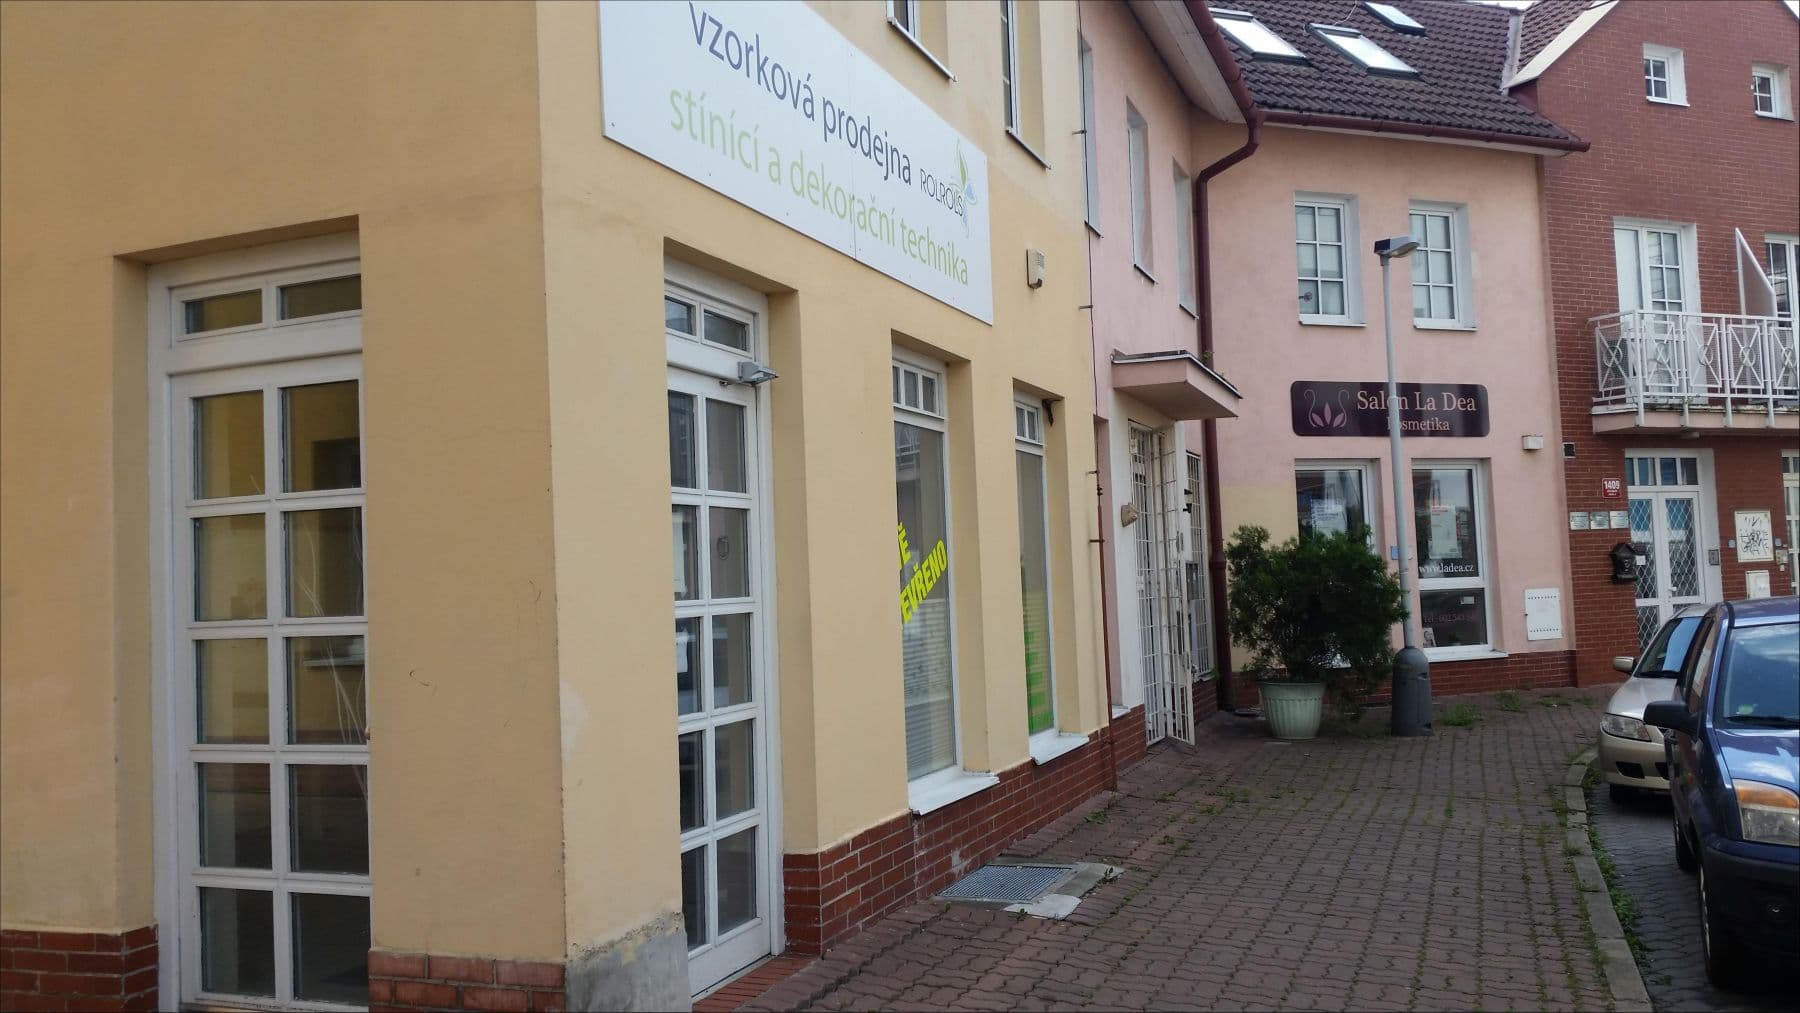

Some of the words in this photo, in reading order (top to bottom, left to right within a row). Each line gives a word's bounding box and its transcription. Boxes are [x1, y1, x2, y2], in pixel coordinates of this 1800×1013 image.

[688, 0, 816, 122] vzorková
[821, 96, 912, 187] prodejna
[669, 88, 760, 173] stínící
[767, 146, 782, 186] a
[789, 149, 897, 248] dekorační
[898, 217, 969, 287] technika
[919, 167, 964, 217] ROLROLS
[1414, 391, 1438, 411] La
[1441, 391, 1478, 412] Dea
[1418, 562, 1475, 573] www.ladea.cz
